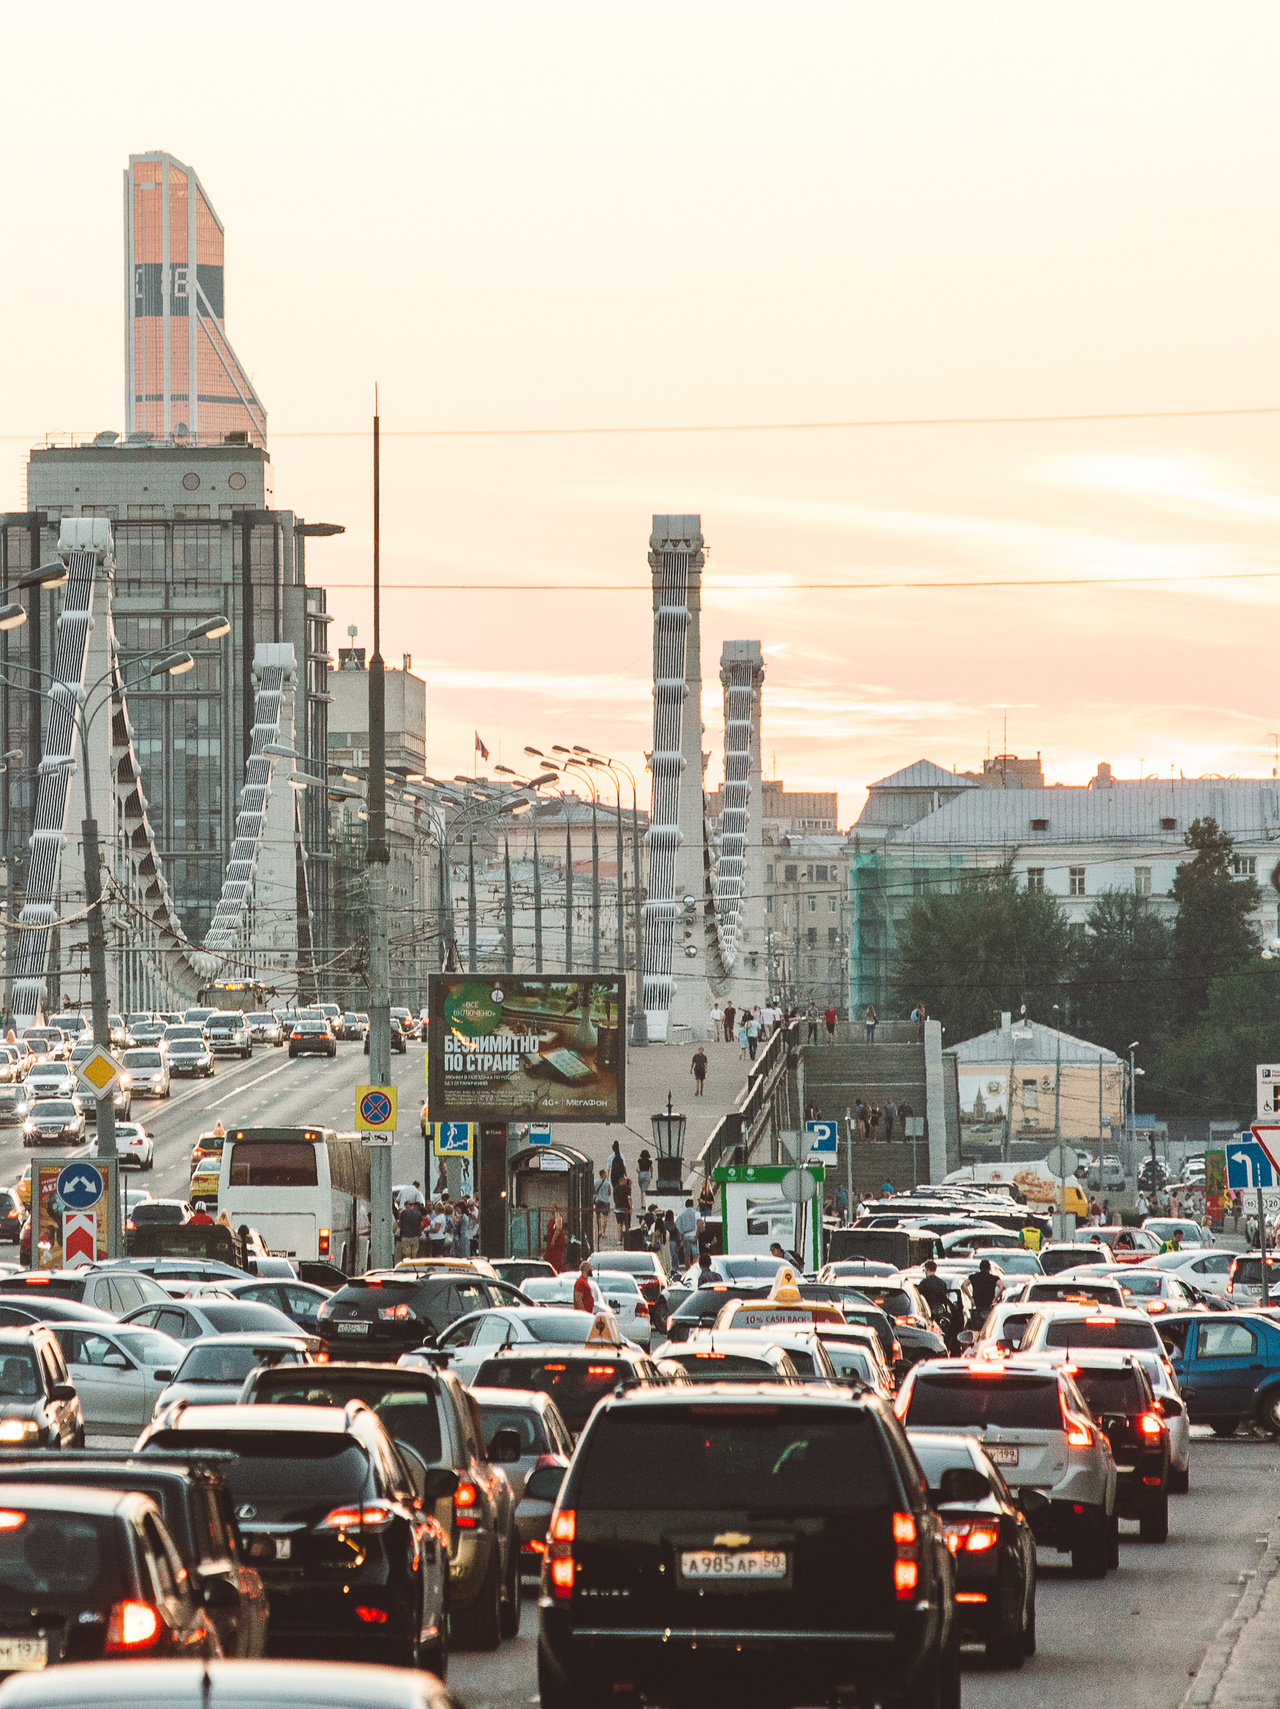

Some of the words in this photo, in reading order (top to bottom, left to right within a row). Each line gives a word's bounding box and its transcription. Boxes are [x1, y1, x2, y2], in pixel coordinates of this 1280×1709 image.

[444, 1054, 463, 1071] ПО
[466, 1054, 520, 1071] СТРАНЕ
[766, 1315, 785, 1323] CASH
[999, 1450, 1016, 1460] 199
[688, 1557, 757, 1574] А985АР
[763, 1554, 781, 1570] 50
